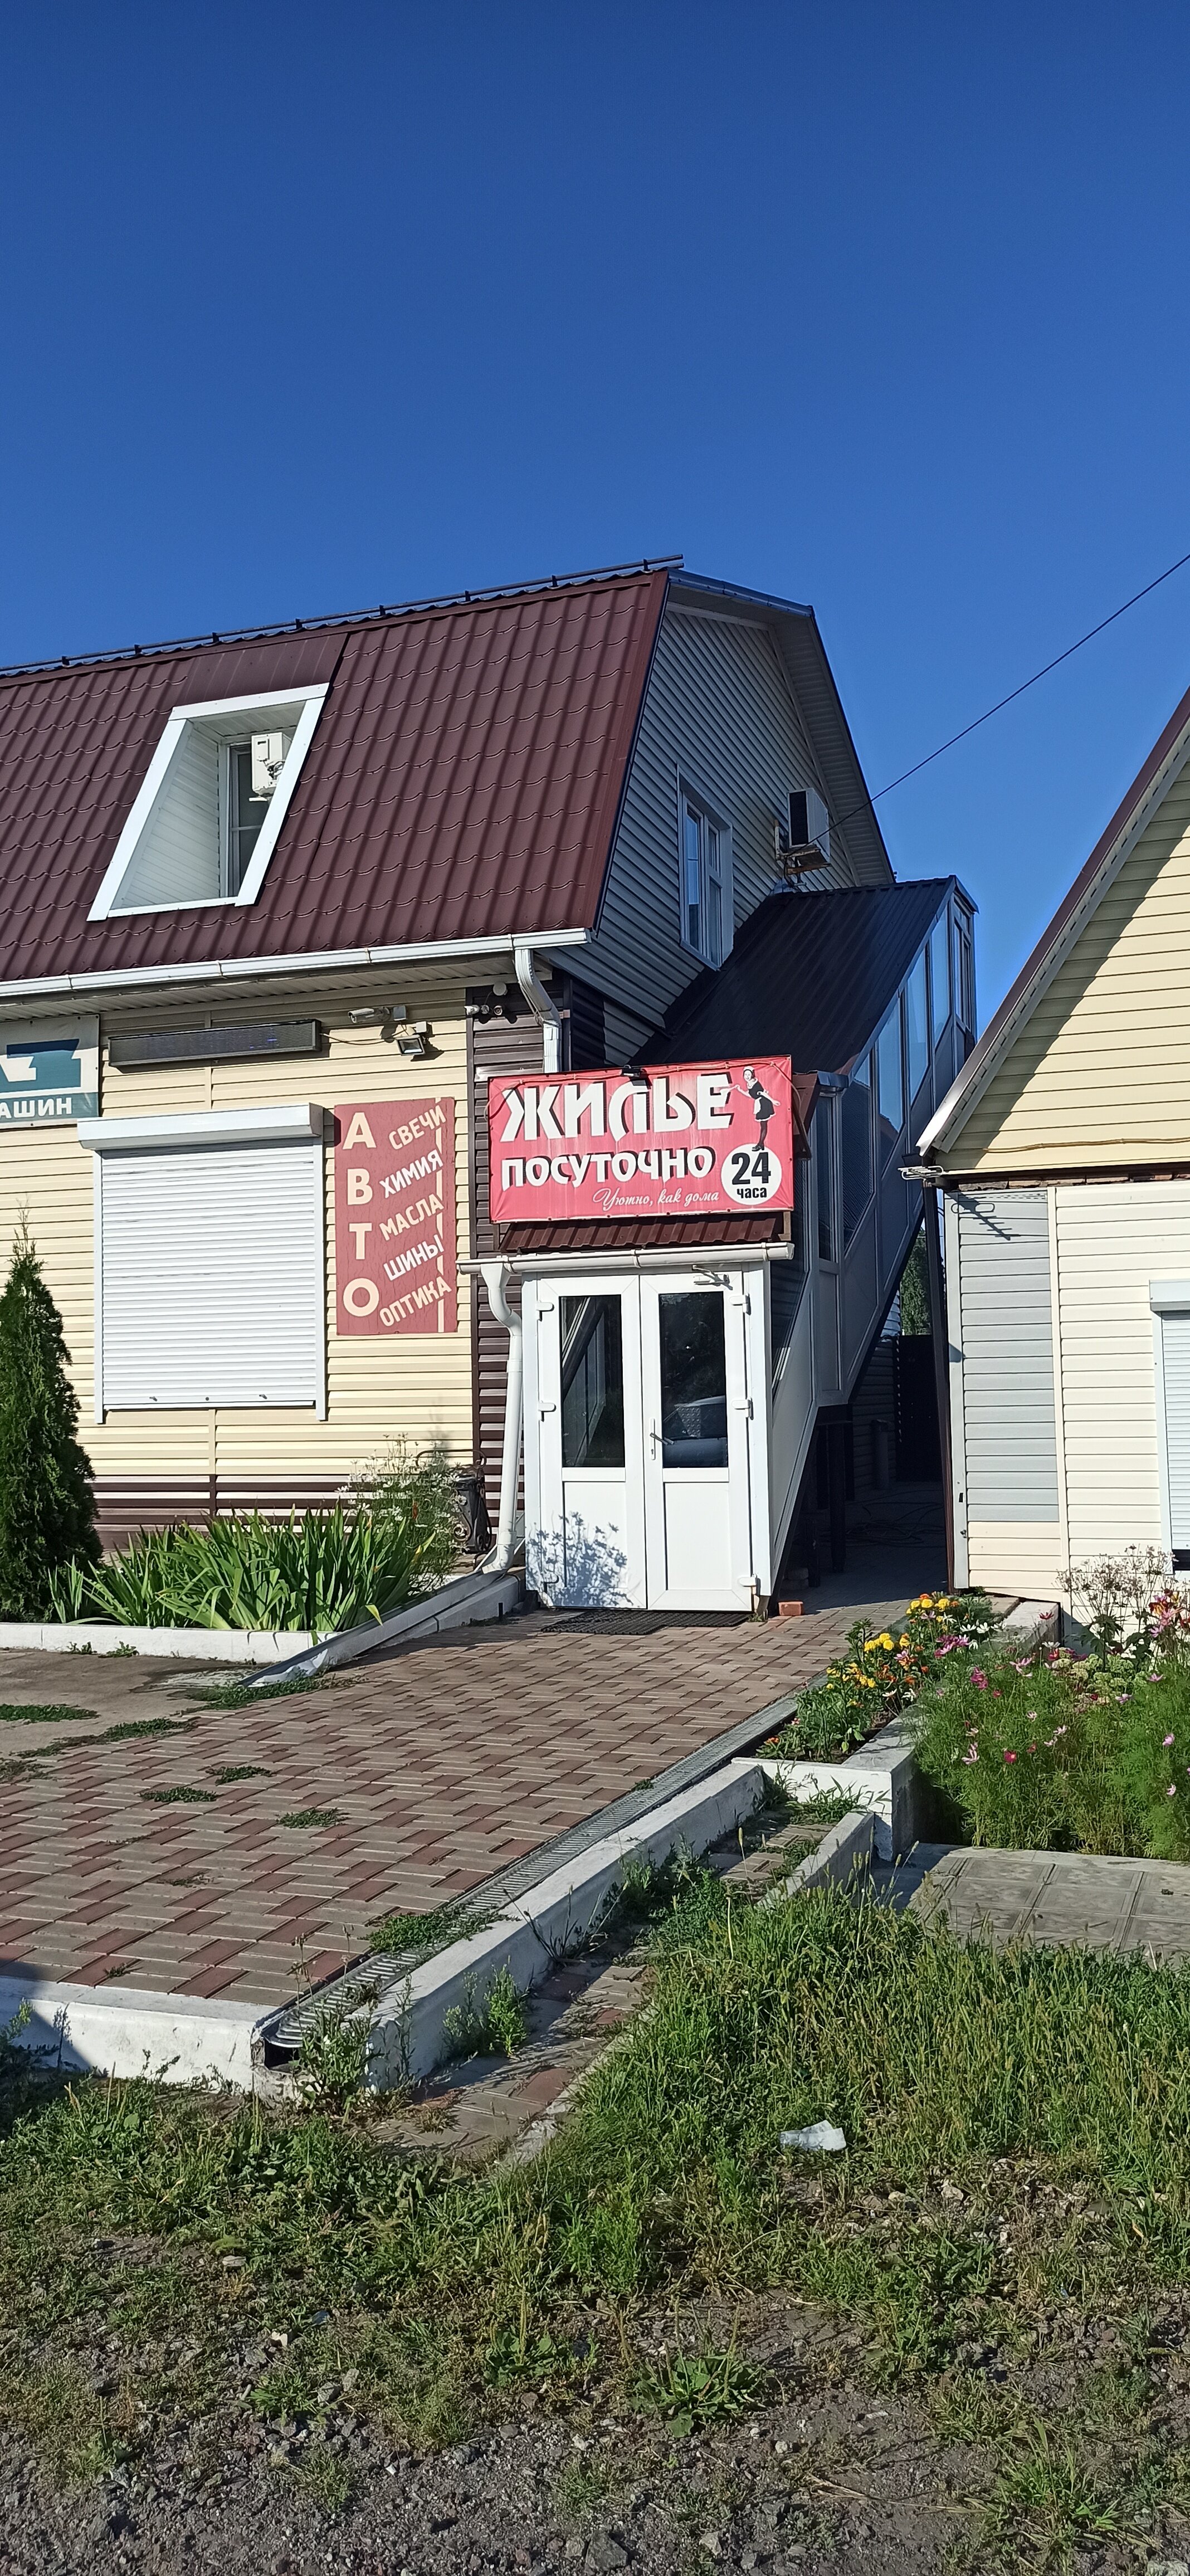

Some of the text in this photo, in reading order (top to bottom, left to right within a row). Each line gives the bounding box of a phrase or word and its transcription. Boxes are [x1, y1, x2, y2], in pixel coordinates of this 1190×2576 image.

[388, 1105, 446, 1150] СВЕЧИ
[500, 1072, 734, 1143] ЖИЛЬЕ
[379, 1149, 443, 1198] ХИМИЯ
[731, 1152, 771, 1185] 24
[592, 1187, 719, 1211] Уютно, как дома
[737, 1187, 767, 1199] часа
[379, 1194, 445, 1241] МАСЛА
[383, 1235, 444, 1281] ШИНЫ
[379, 1276, 452, 1326] ОПТИКА
